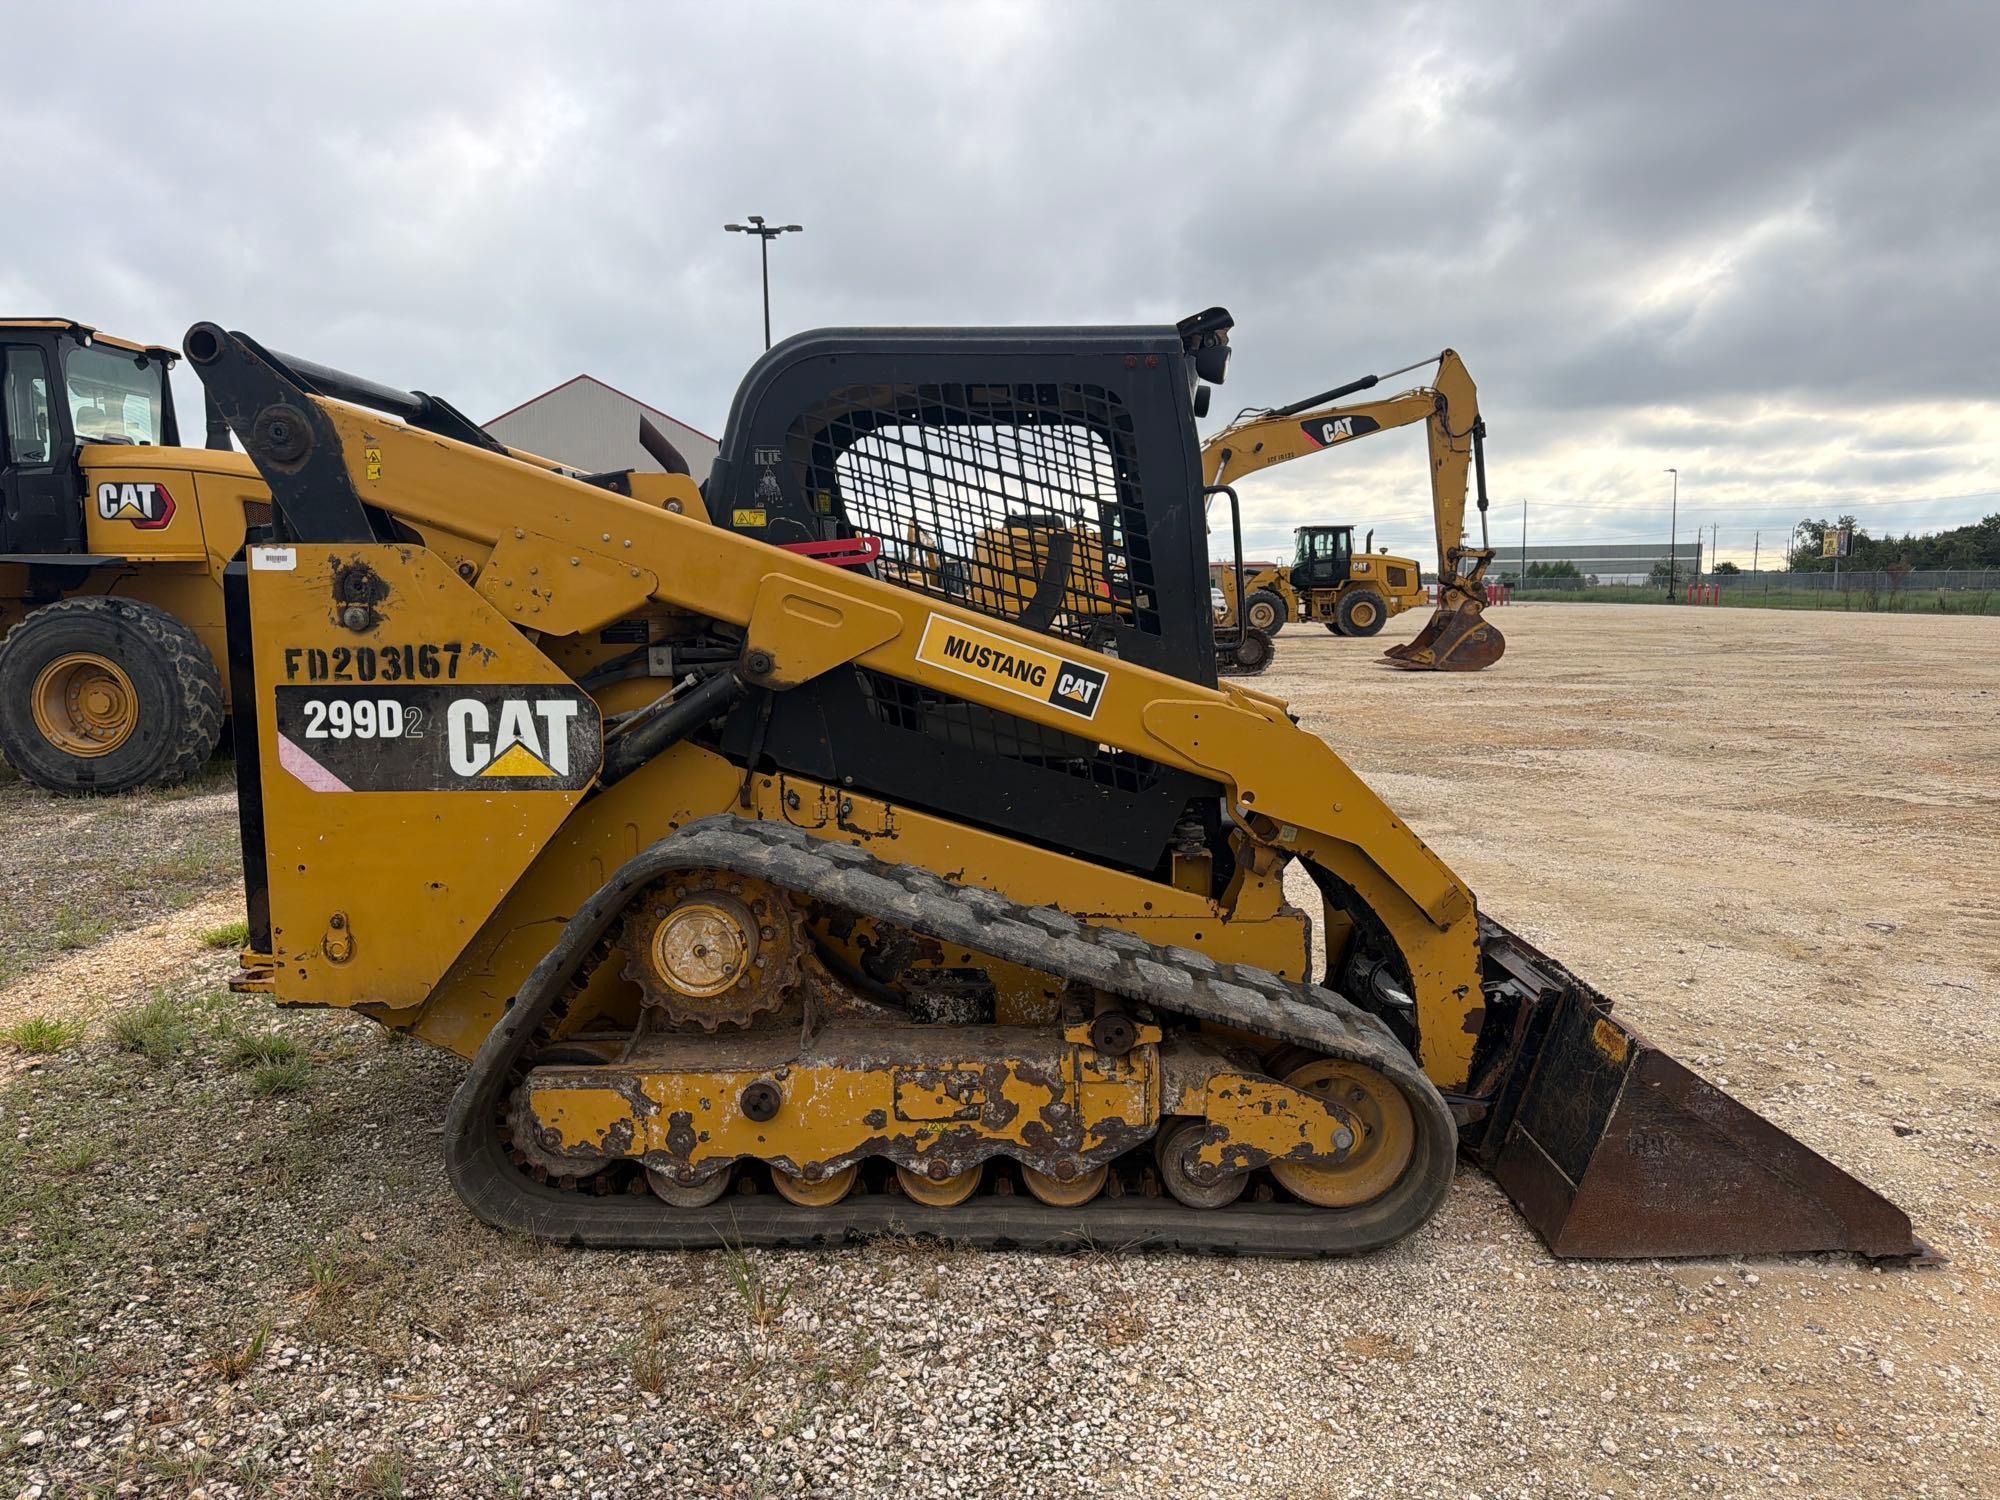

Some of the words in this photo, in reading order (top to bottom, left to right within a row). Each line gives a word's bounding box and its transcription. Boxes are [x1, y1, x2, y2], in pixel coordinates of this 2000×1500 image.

[1322, 417, 1353, 443] CAT
[98, 483, 156, 519] CAT
[1352, 562, 1368, 571] CAT
[285, 643, 462, 682] FD203167
[943, 635, 1047, 687] MUSTANG
[1057, 673, 1098, 703] CAT
[446, 699, 578, 777] CAT
